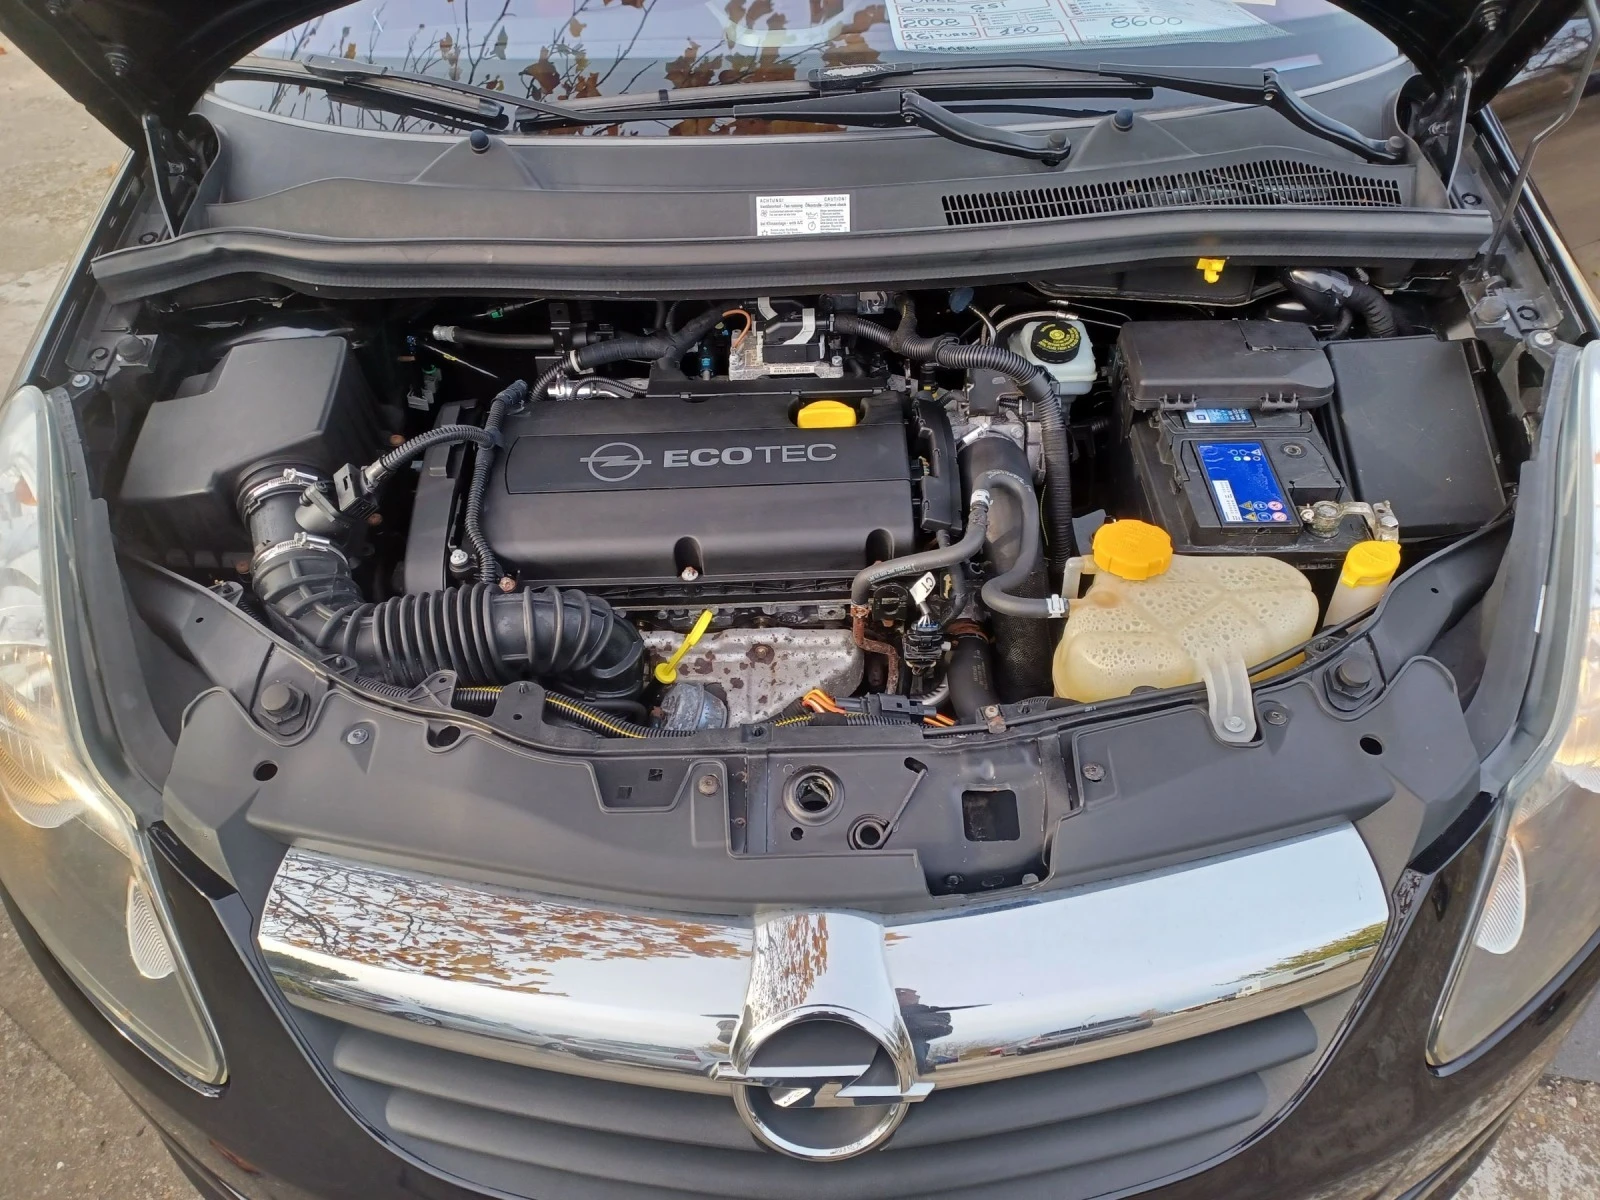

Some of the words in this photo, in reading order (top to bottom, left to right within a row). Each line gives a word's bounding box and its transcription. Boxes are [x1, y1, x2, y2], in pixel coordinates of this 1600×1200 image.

[902, 18, 960, 28] 2008
[1111, 16, 1182, 28] 8600
[663, 443, 837, 468] ECOTEC
